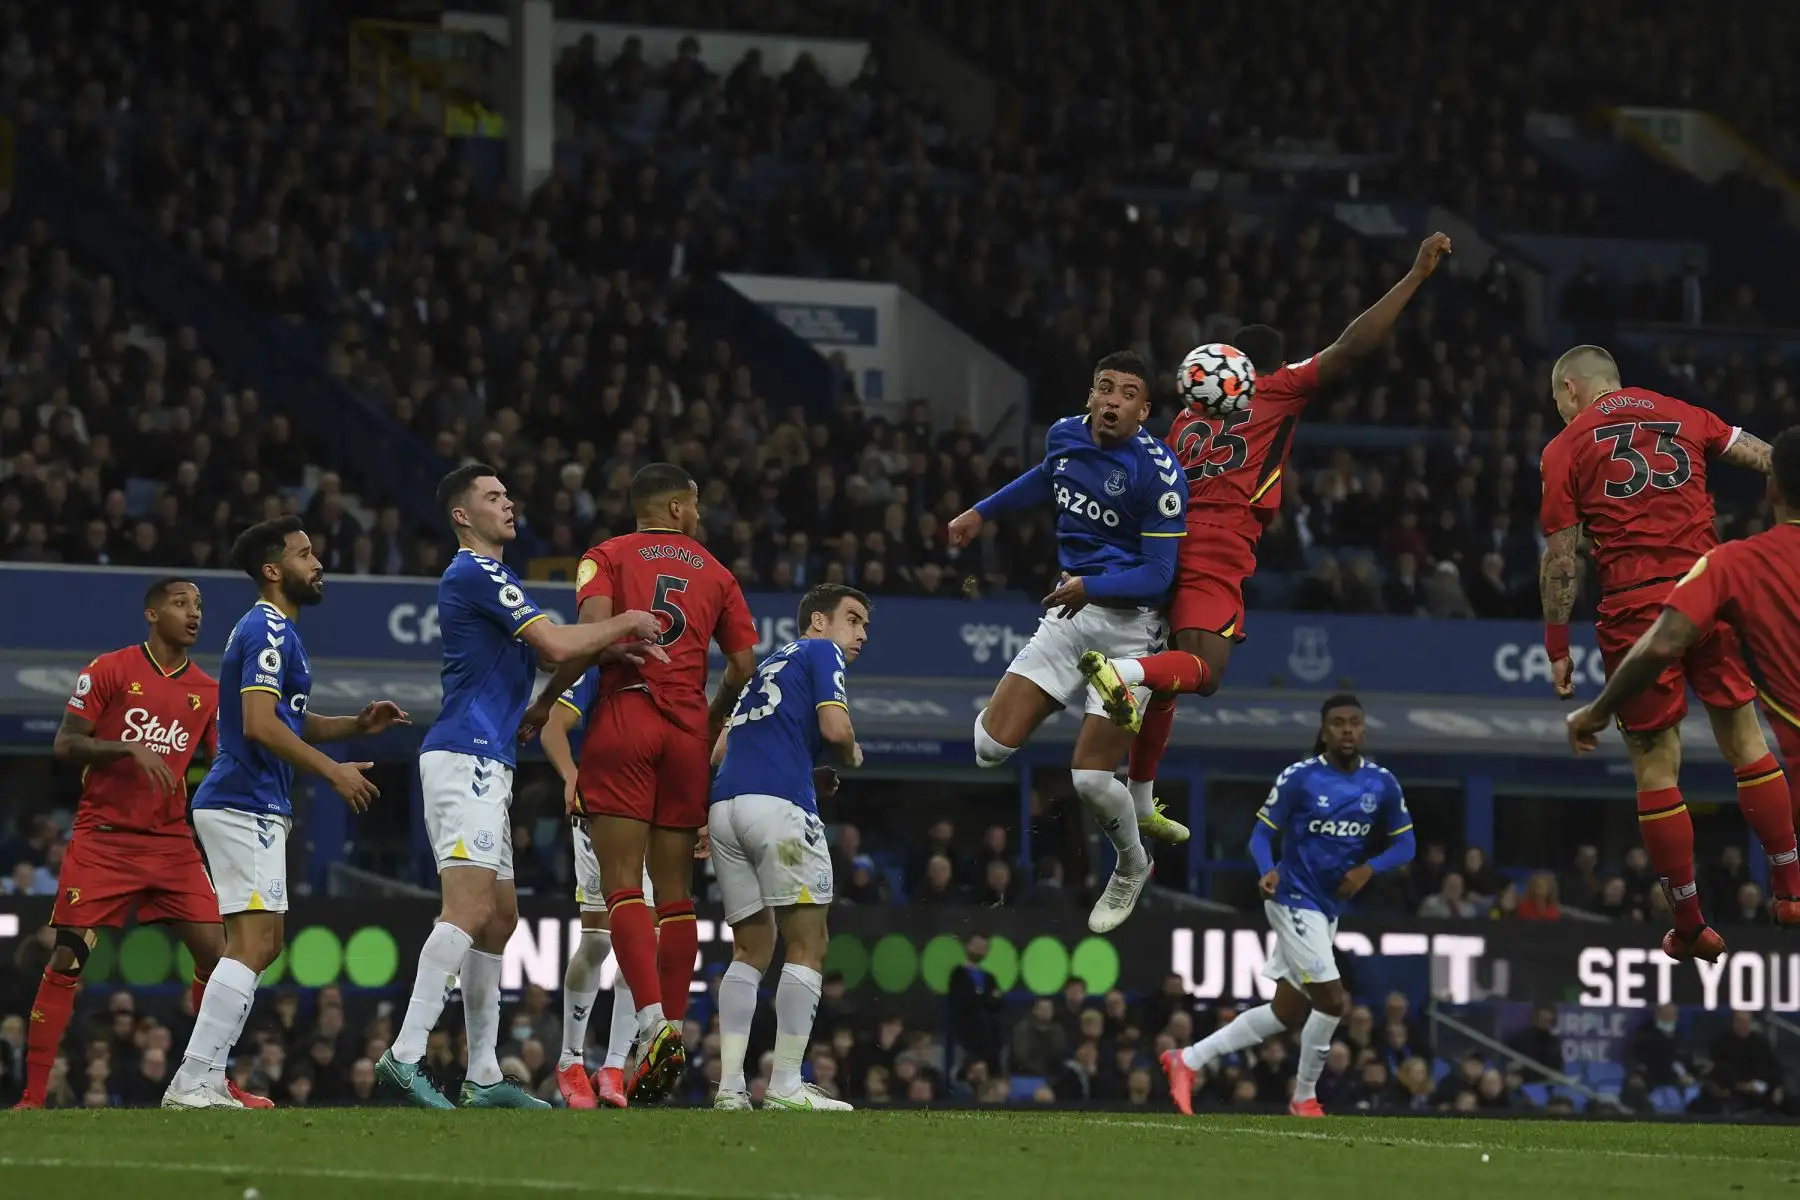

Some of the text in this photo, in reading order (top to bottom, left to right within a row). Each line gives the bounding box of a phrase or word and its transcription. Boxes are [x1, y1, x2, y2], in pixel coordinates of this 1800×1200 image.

[1595, 395, 1656, 415] KUCO
[1177, 408, 1253, 482] 25
[1593, 421, 1691, 498] 33
[638, 544, 704, 569] EKONG
[645, 573, 688, 647] 5
[1493, 643, 1606, 685] CAZO
[725, 660, 788, 726] 23
[121, 708, 190, 752] Stake
[1308, 819, 1371, 837] CAZOO
[1578, 946, 1676, 1008] SET
